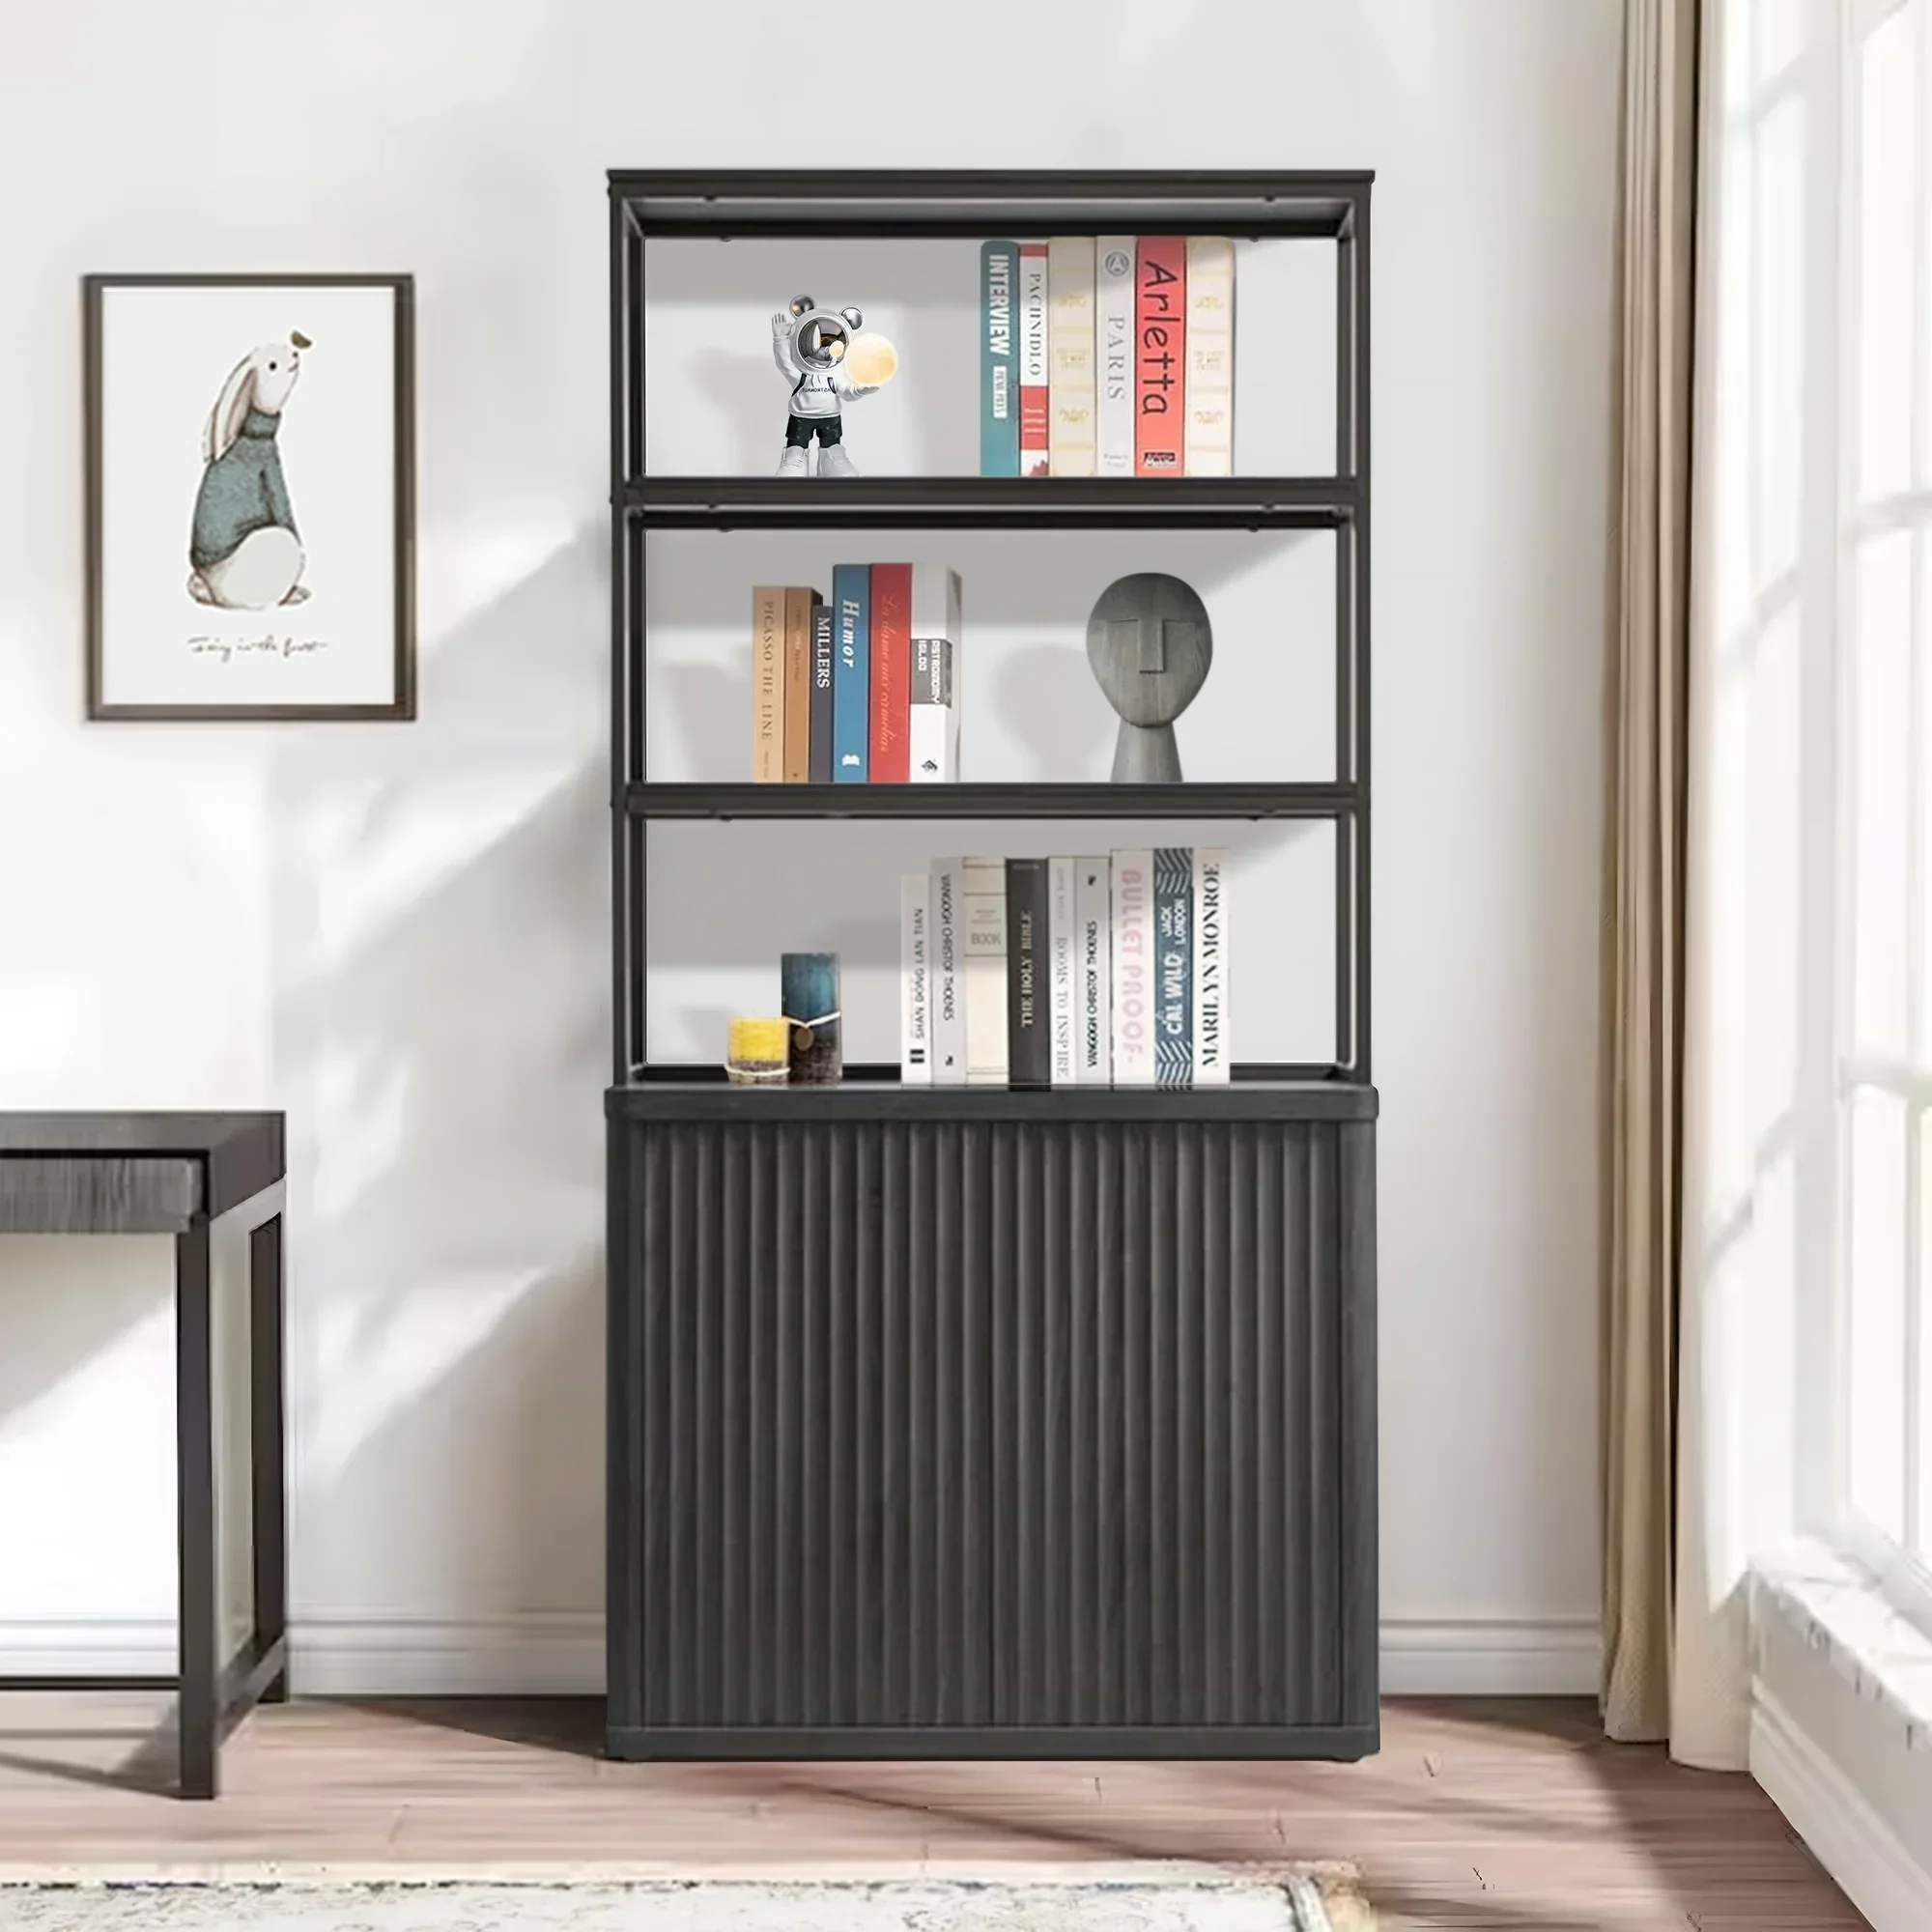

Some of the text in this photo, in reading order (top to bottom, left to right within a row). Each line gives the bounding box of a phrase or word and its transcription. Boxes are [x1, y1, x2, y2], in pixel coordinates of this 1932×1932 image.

[989, 254, 1010, 355] INTERVIEW
[1143, 260, 1180, 414] Arletta
[1108, 316, 1124, 400] PARIS
[763, 601, 774, 662] PICASSO
[817, 617, 830, 688] MILLERS
[842, 599, 860, 668] Humor
[762, 668, 773, 696] THE
[762, 704, 773, 740] LINE
[971, 932, 1002, 946] BOOK
[1122, 869, 1143, 955] BULLET
[1161, 906, 1172, 937] JACK
[1174, 898, 1186, 946] LONDON
[915, 940, 923, 964] LAN
[1021, 911, 1033, 1028] THE HOLY BIBLE
[1203, 863, 1219, 1067] MARILYN MONROE
[915, 968, 924, 1003] DONG
[1057, 937, 1069, 1077] ROOMS TO INSPIRE
[914, 1007, 924, 1039] SHAN
